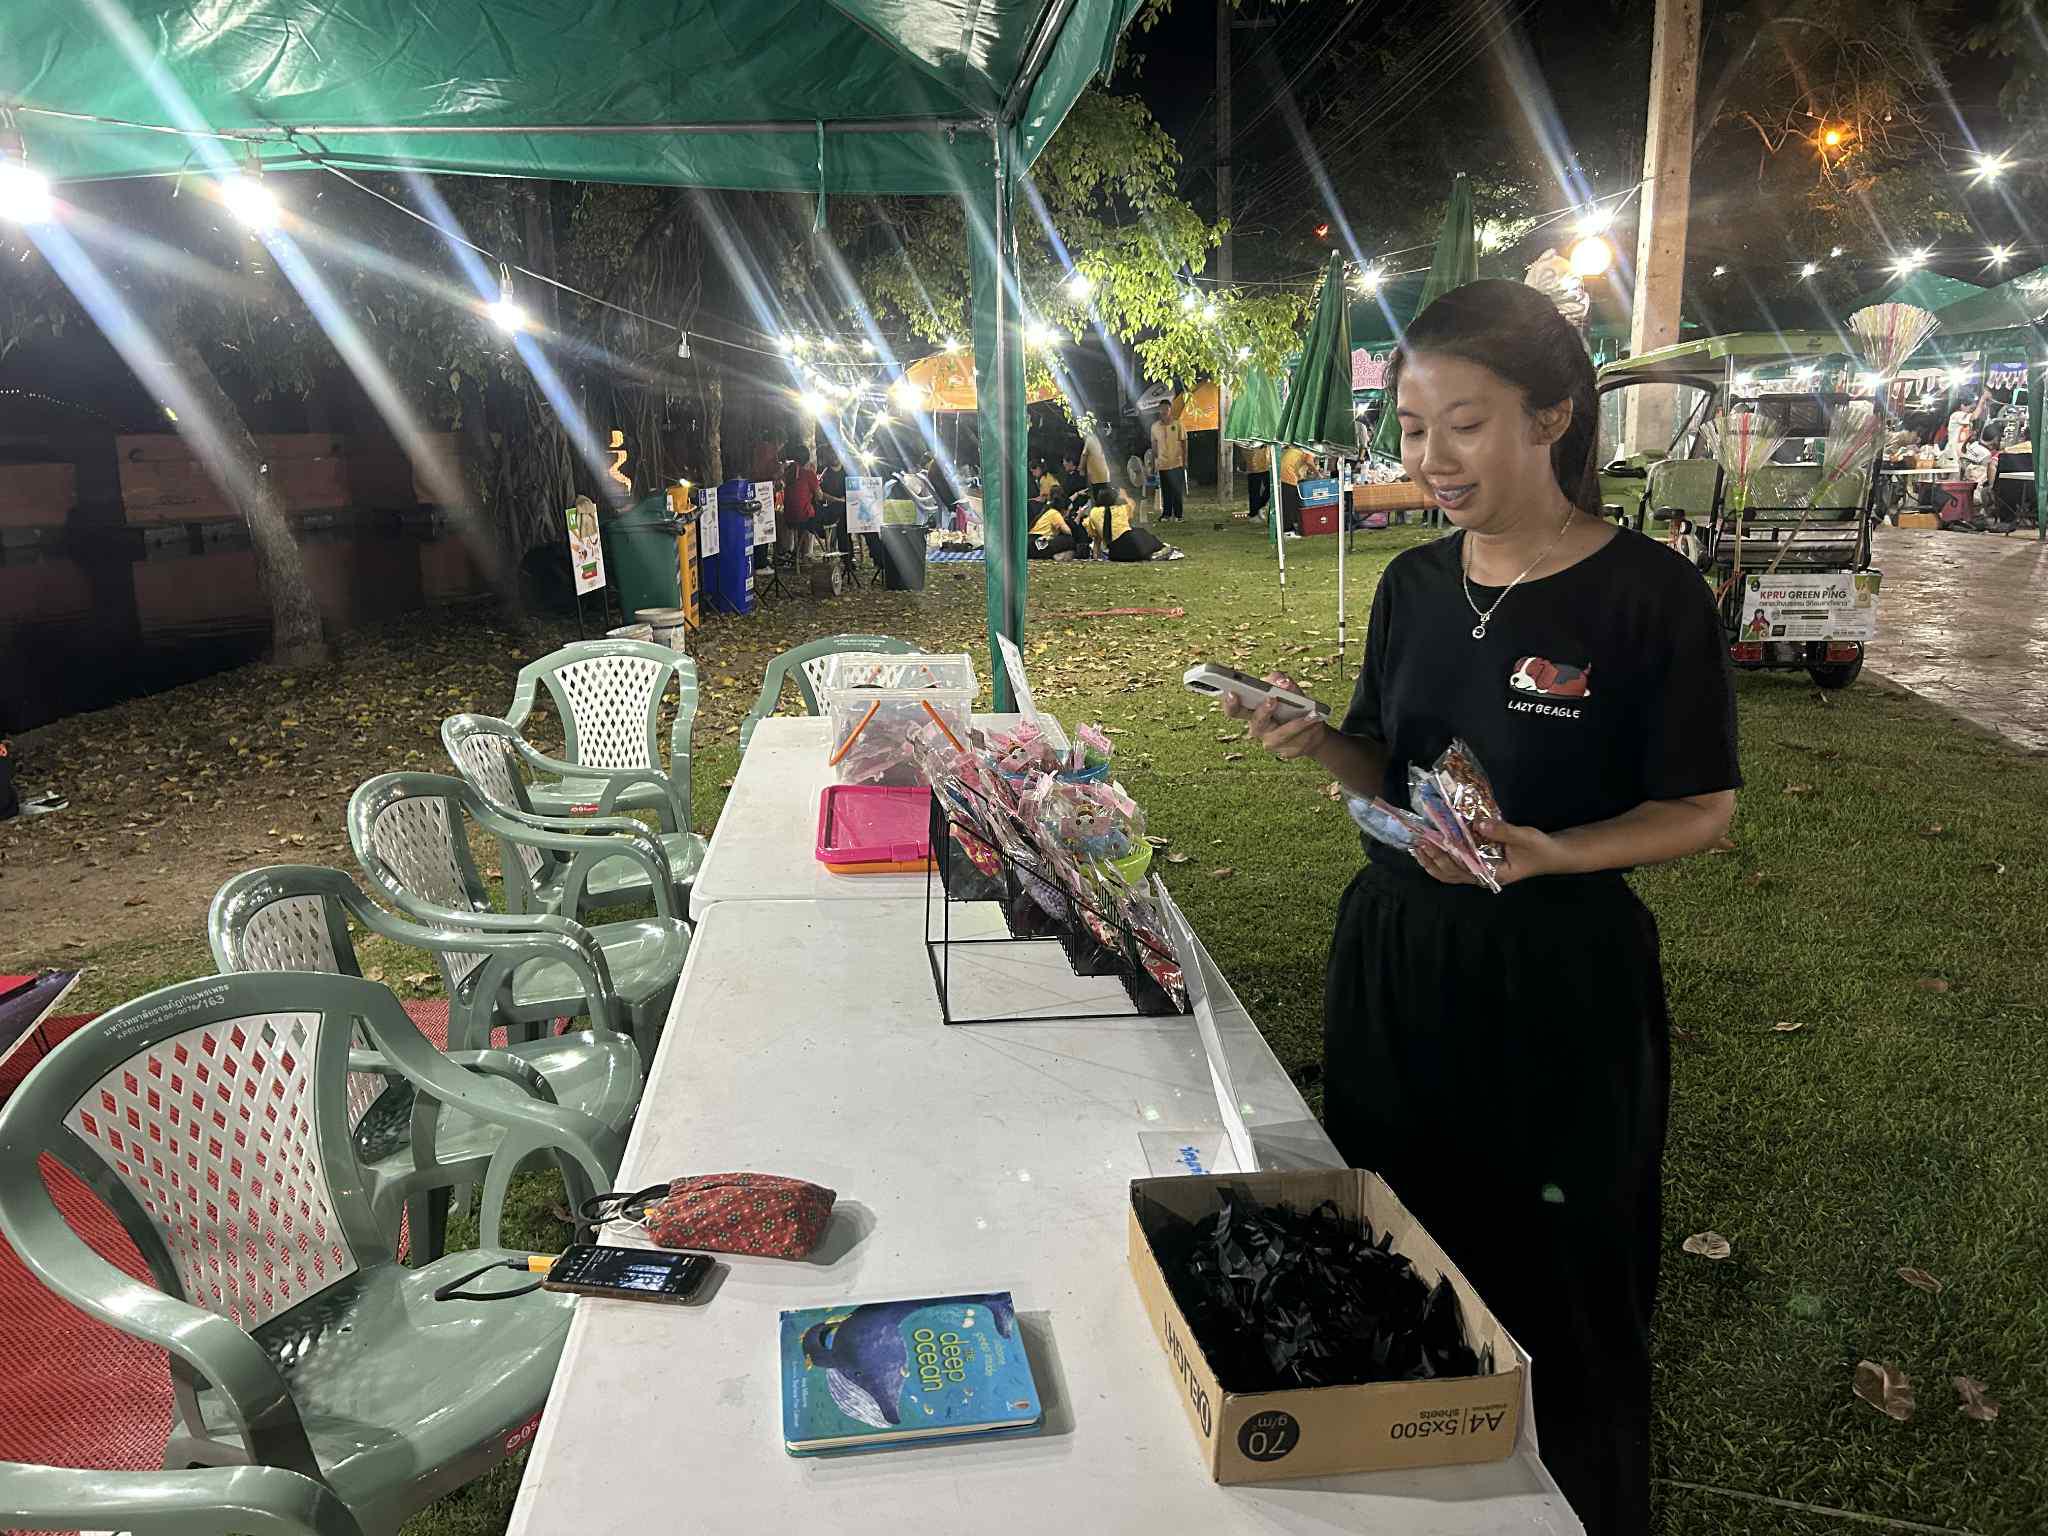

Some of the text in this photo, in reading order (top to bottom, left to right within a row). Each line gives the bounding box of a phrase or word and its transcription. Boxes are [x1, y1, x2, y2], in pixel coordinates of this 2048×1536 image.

[1760, 590, 1847, 599] KPRU GREEN PING
[1508, 700, 1582, 718] LAZY BEAGLE
[914, 1328, 944, 1392] ocean
[939, 1331, 970, 1383] deep
[1390, 1411, 1506, 1440] A4 5x500
[1419, 1407, 1460, 1419] sheets
[1249, 1431, 1286, 1456] 70
